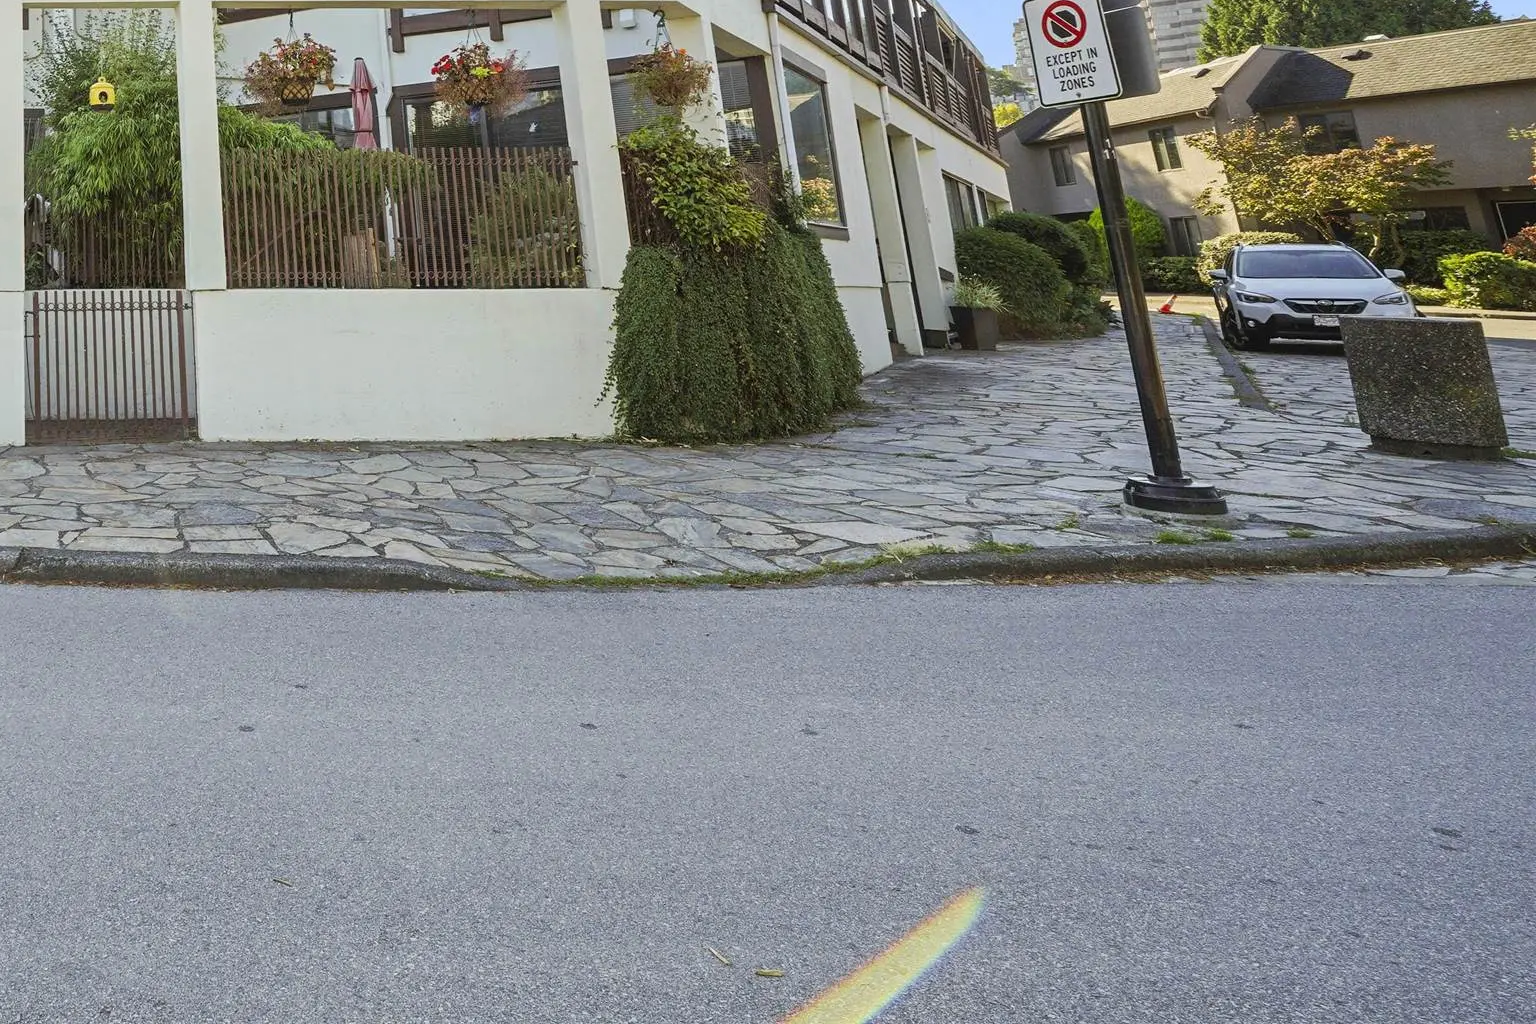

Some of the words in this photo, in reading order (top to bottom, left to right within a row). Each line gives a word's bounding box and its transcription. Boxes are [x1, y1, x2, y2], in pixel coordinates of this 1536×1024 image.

[1046, 49, 1082, 67] EXCEPT
[1086, 47, 1098, 59] IN
[1052, 61, 1096, 79] LOADING
[1059, 76, 1095, 92] ZONES
